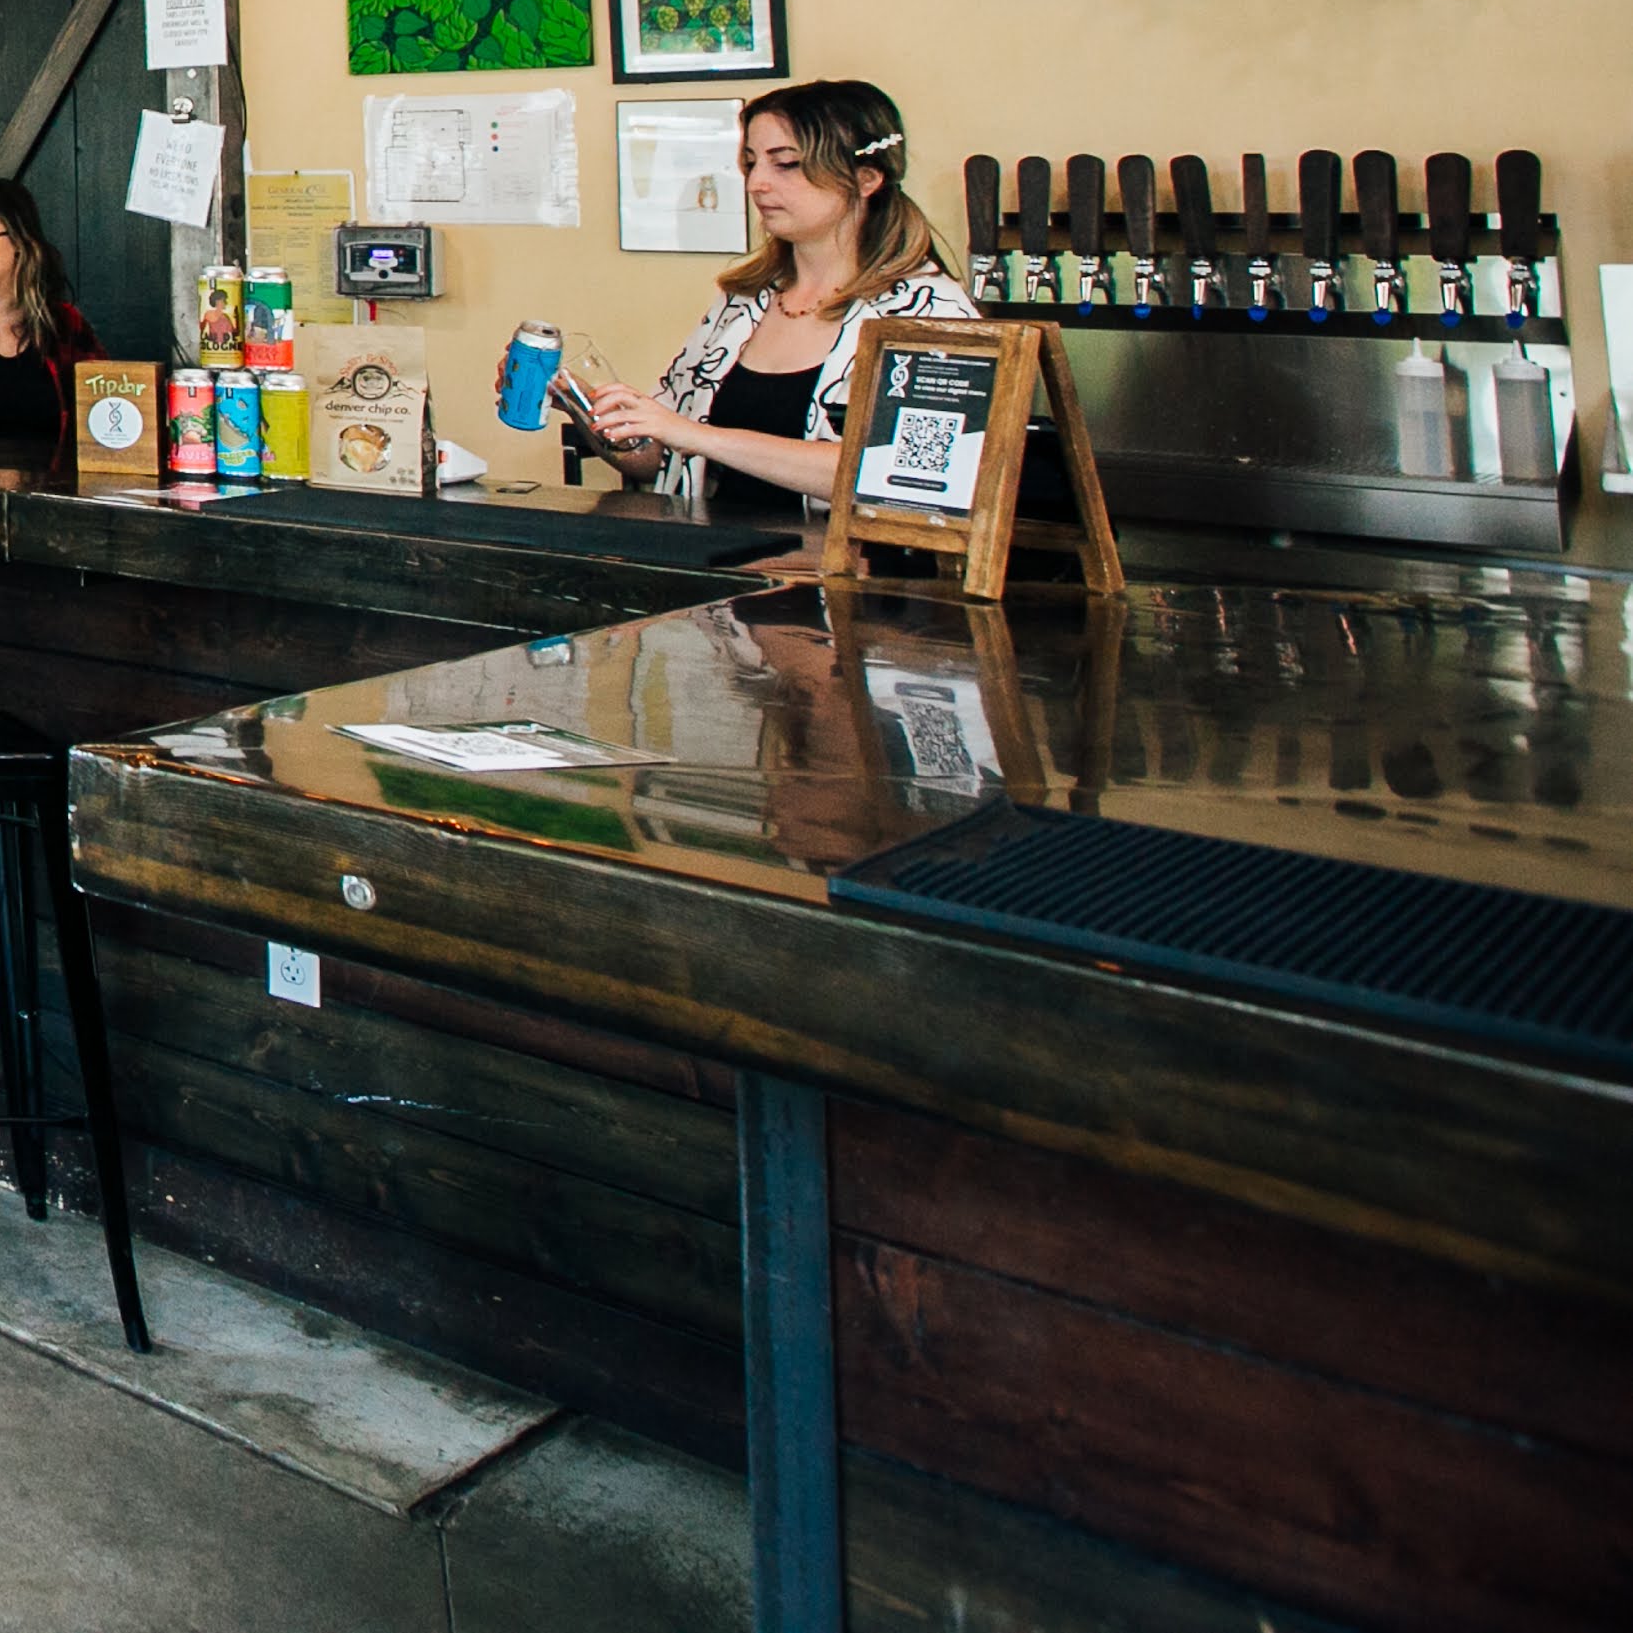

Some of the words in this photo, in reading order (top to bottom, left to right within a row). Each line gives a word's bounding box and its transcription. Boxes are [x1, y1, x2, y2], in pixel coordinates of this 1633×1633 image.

[84, 373, 118, 396] Tip
[325, 400, 365, 412] denver
[368, 403, 393, 416] chip
